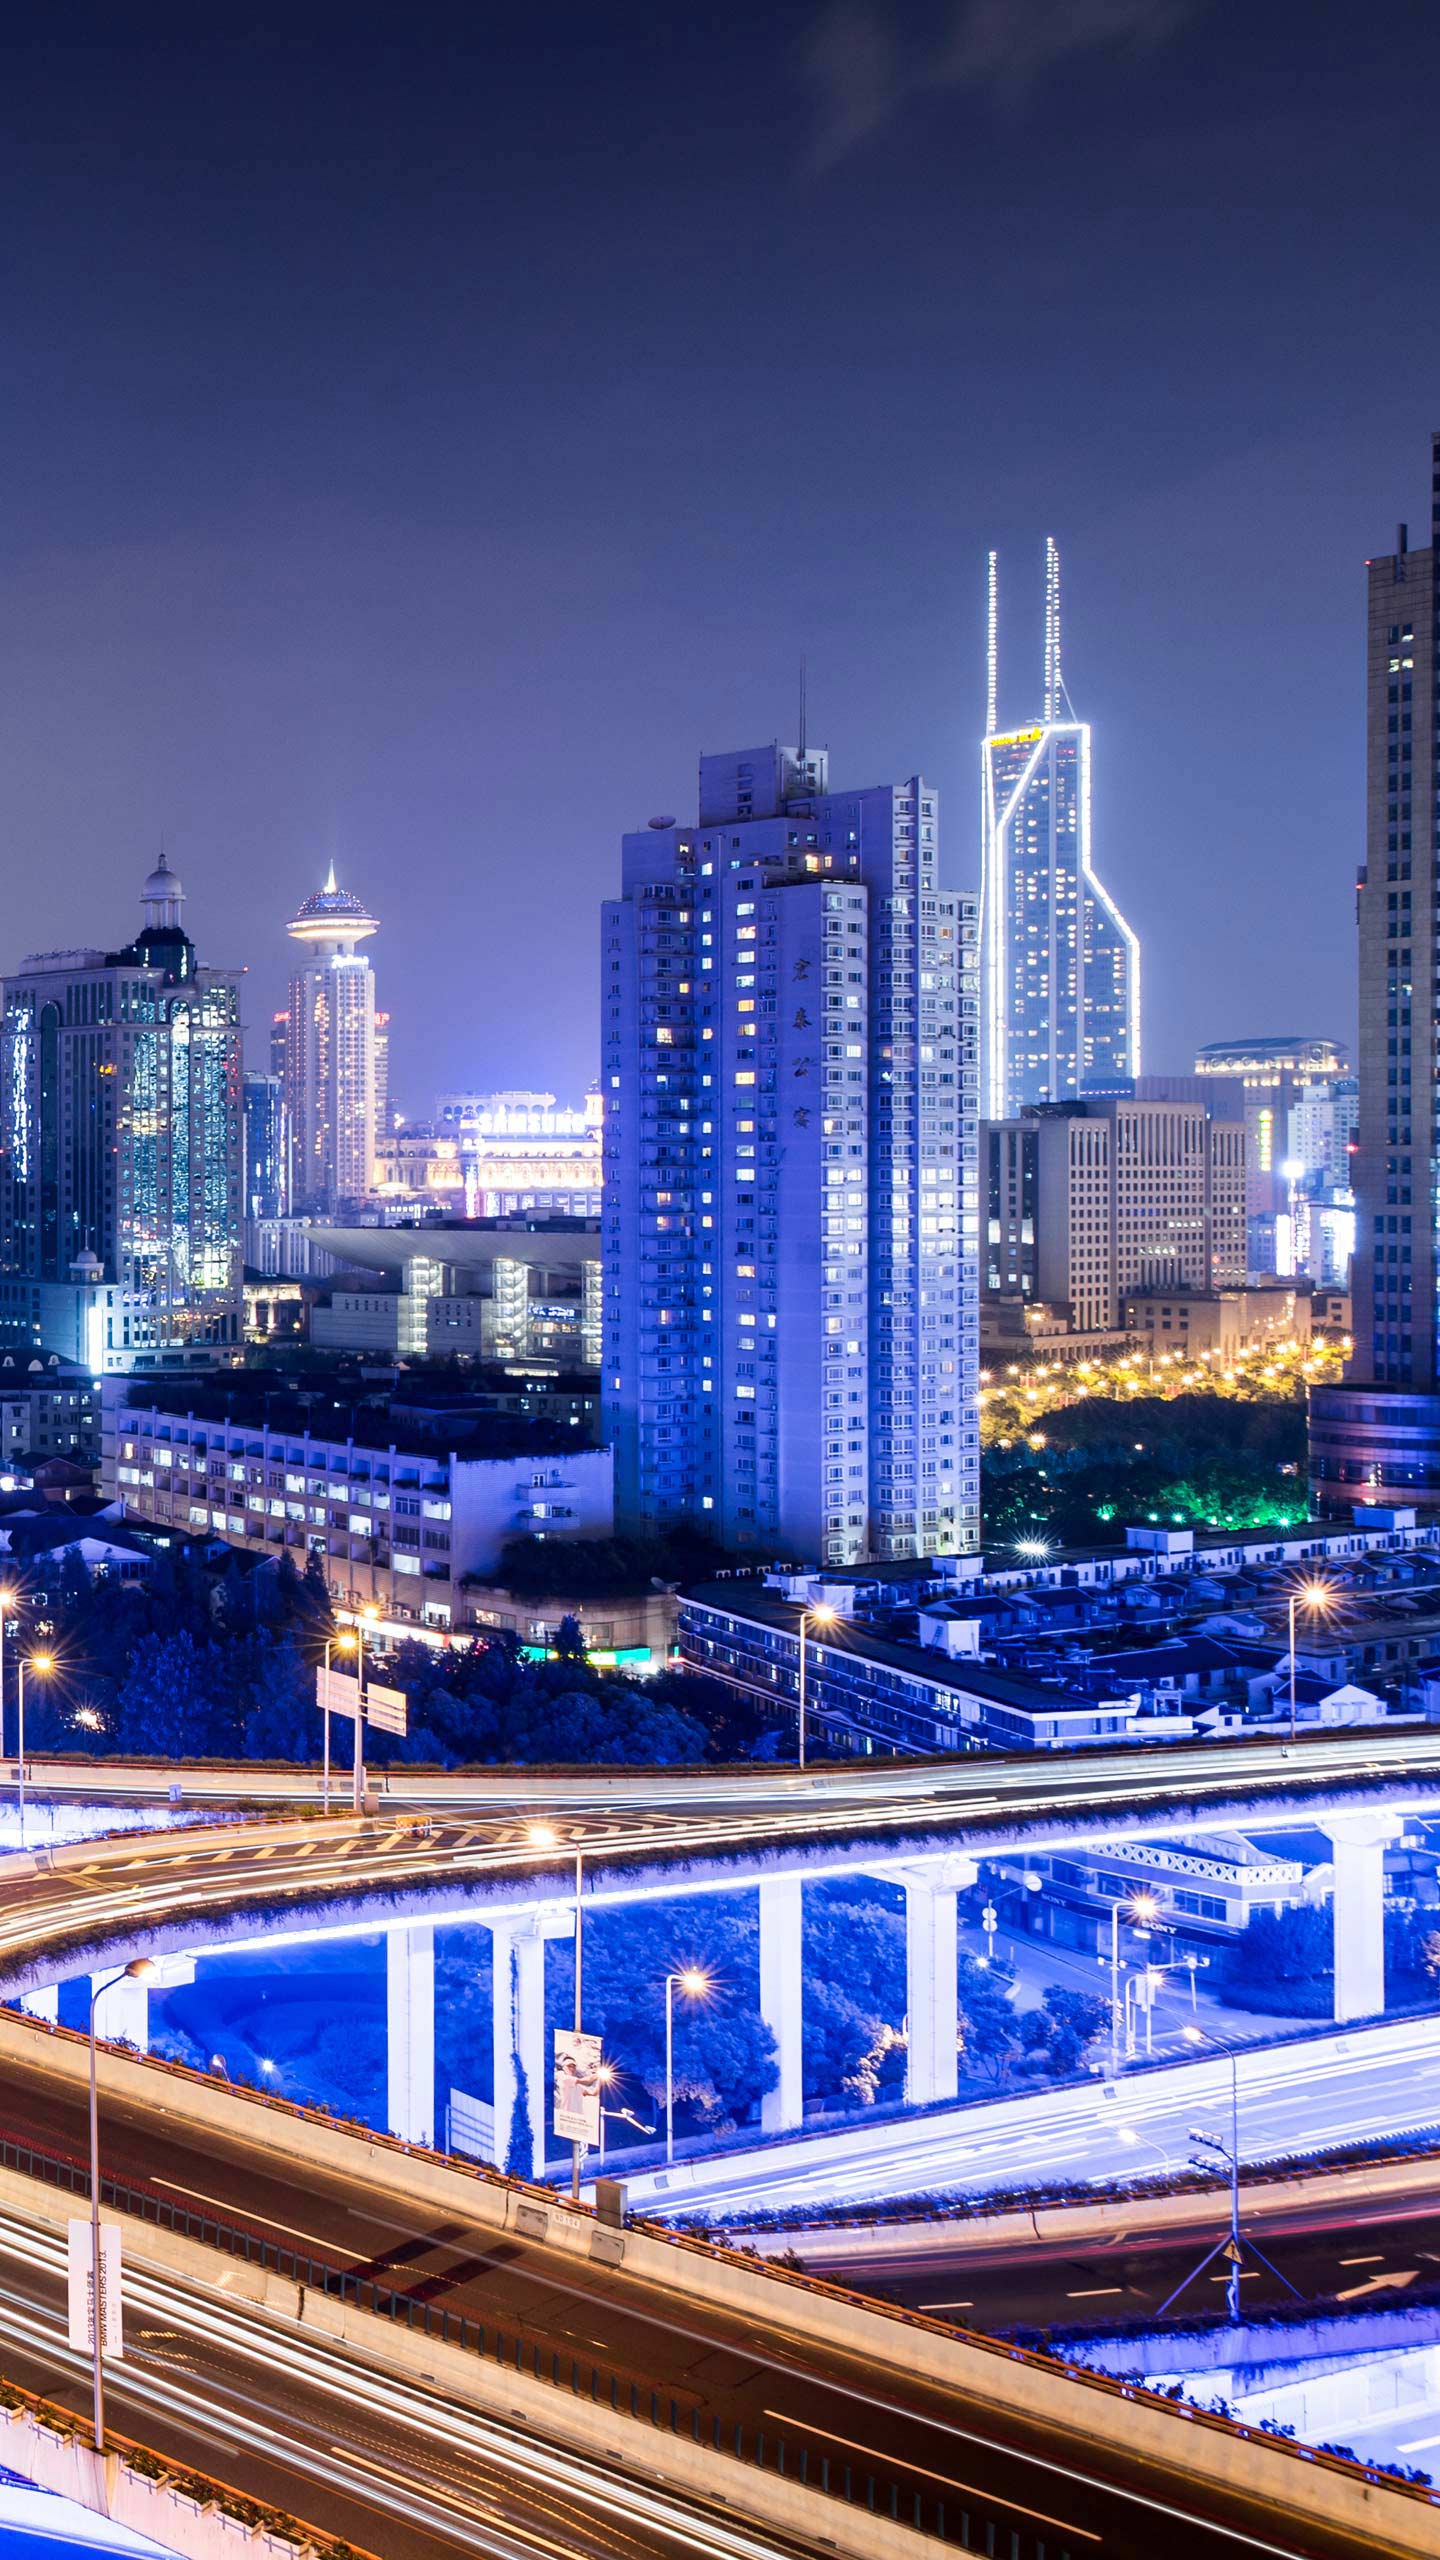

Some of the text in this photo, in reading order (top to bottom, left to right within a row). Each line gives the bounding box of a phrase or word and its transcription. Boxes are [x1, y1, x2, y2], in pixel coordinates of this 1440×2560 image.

[480, 1113, 585, 1133] SAMSUNG
[1141, 1920, 1177, 1934] SONY
[99, 2275, 107, 2322] MASTERS
[99, 2323, 108, 2347] BMW
